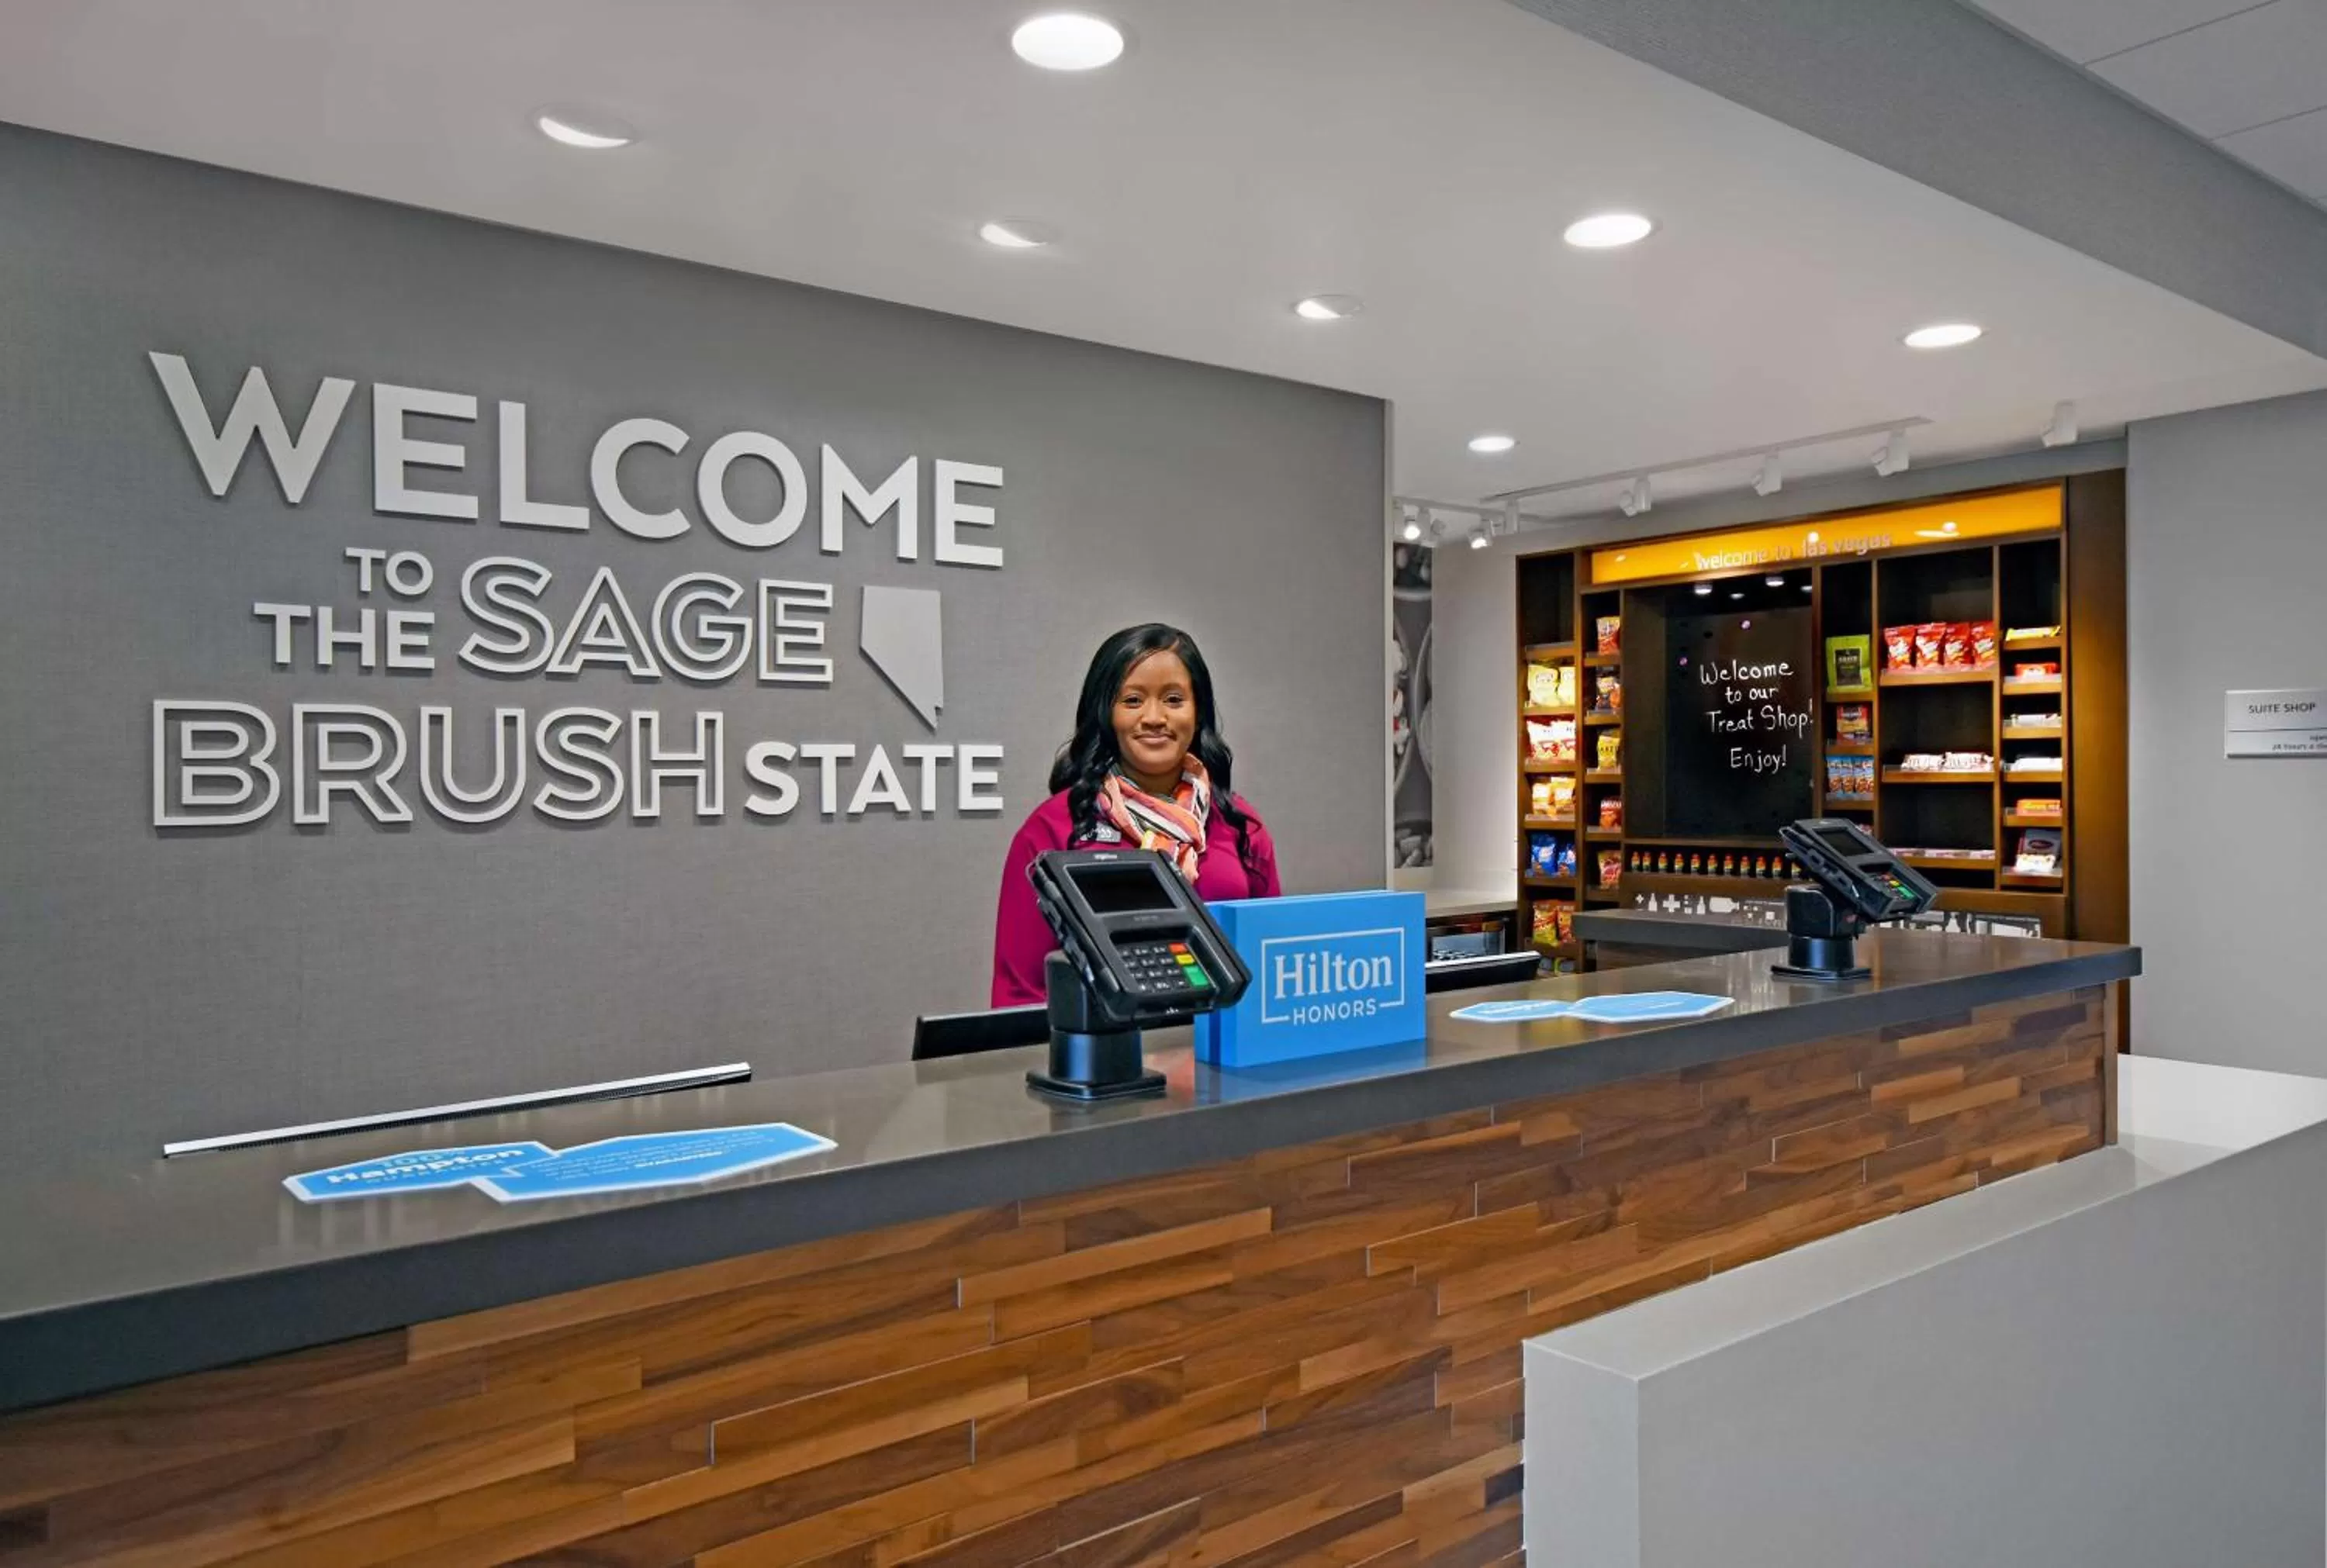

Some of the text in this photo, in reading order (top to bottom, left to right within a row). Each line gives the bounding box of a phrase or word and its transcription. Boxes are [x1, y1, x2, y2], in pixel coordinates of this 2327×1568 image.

[148, 351, 1003, 567] WELCOME
[345, 547, 434, 596] TO
[254, 603, 434, 669] THE
[459, 556, 833, 682] SAGE
[1699, 659, 1794, 685] Welcome
[1725, 686, 1779, 704] to our
[2249, 702, 2316, 714] SUITE SHOP
[1706, 698, 1814, 739] Treat Shop!
[154, 699, 1004, 826] BRUSH STATE
[1731, 744, 1786, 774] Enjoy!
[1274, 950, 1394, 1000] Hilton
[1293, 998, 1377, 1026] HONORS
[326, 1149, 524, 1184] Hampton
